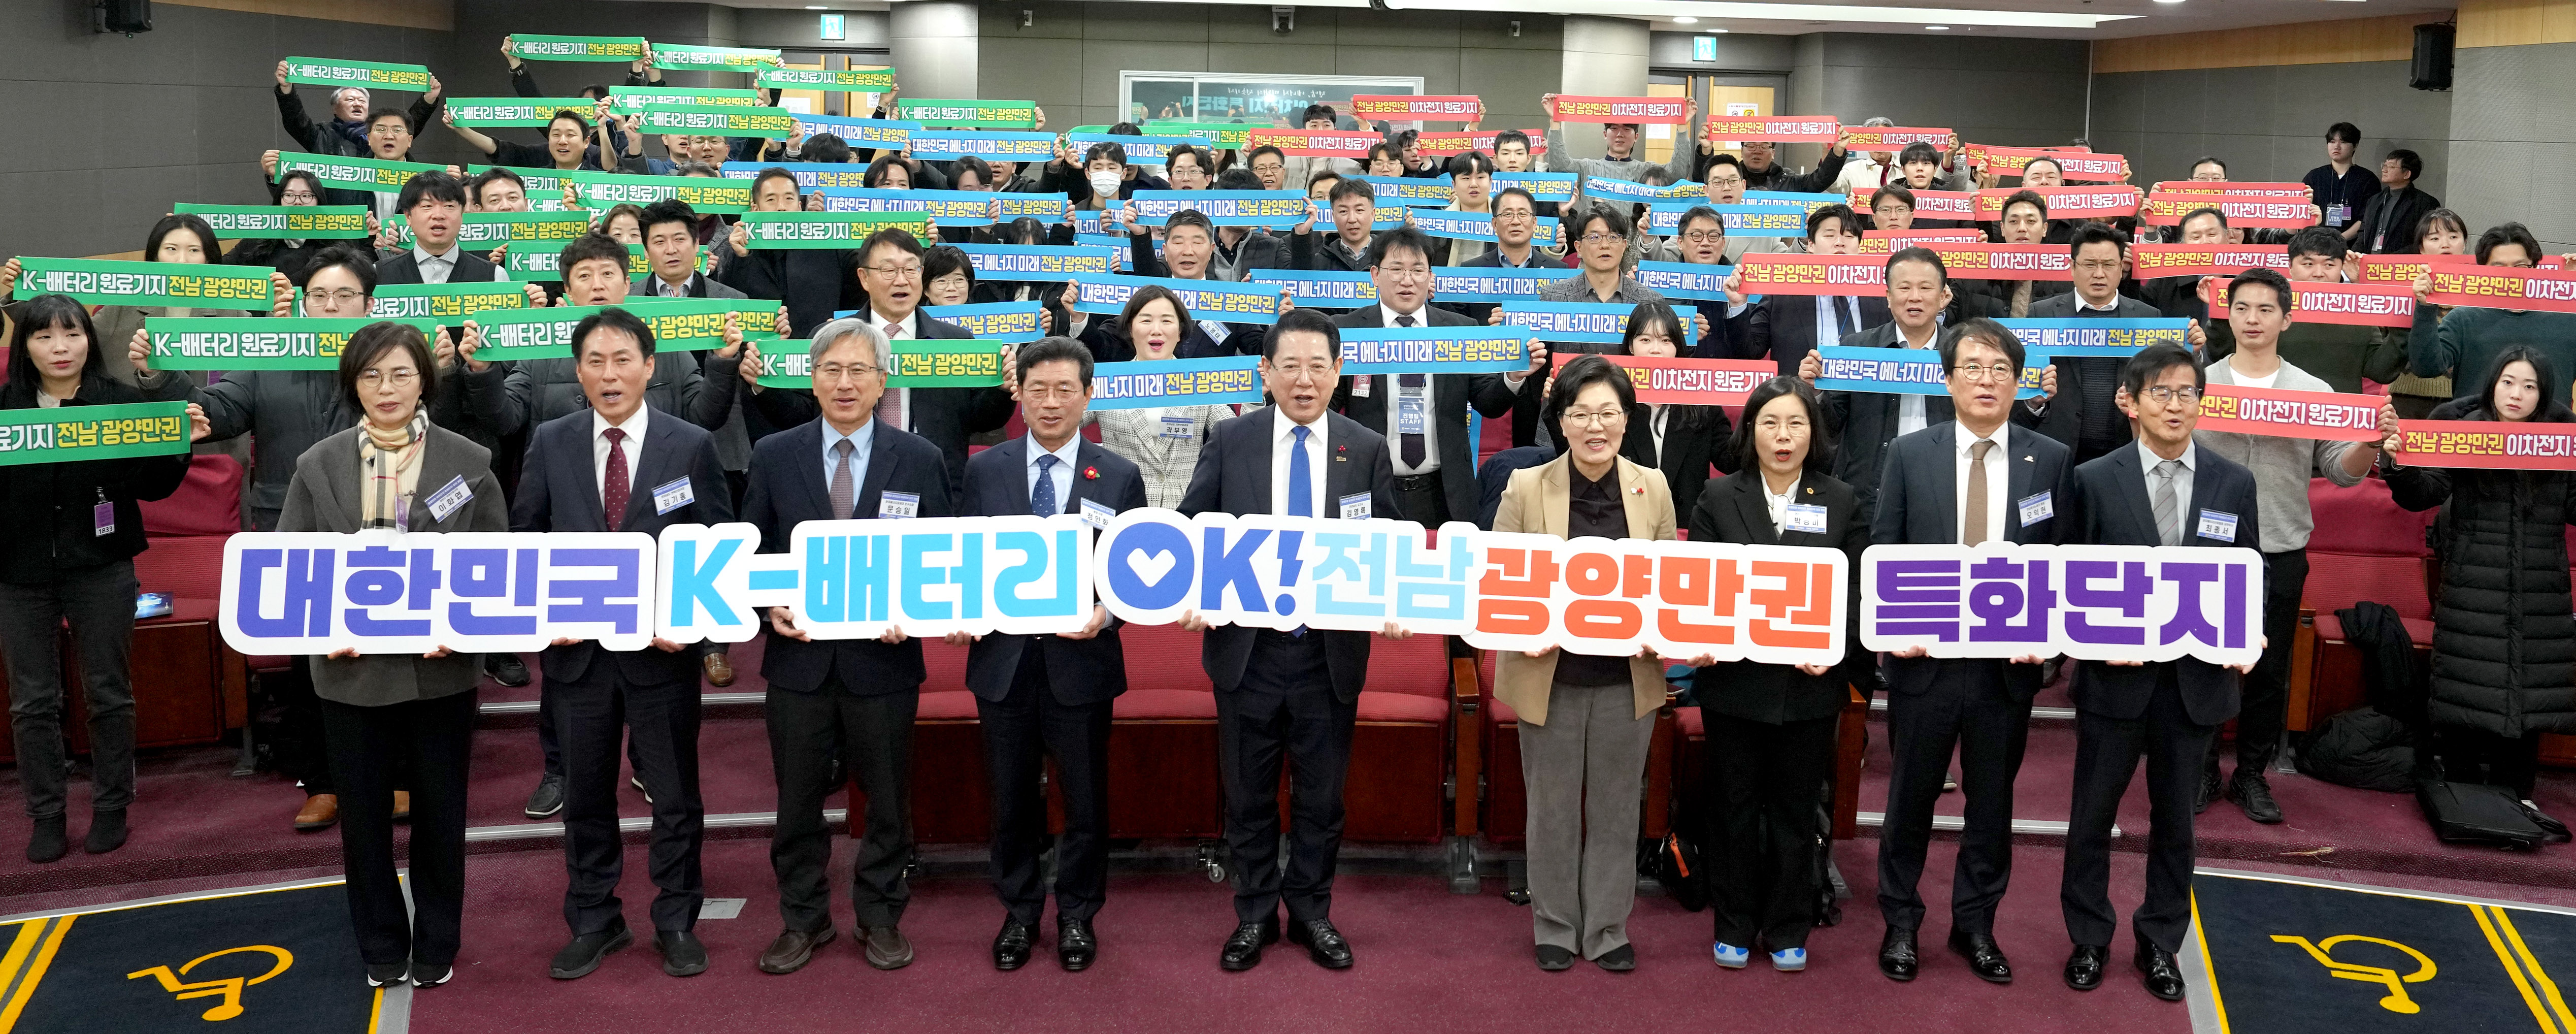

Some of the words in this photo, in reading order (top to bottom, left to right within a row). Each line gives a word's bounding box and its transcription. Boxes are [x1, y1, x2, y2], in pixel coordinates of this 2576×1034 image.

[512, 41, 550, 54] K-배터리
[551, 43, 586, 55] 원료기지
[588, 43, 605, 55] 전남
[606, 44, 641, 56] 광양만권
[289, 63, 331, 79] K-배터리
[333, 67, 370, 81] 원료기지
[371, 70, 390, 82] 전남
[391, 71, 427, 85] 광양만권
[758, 68, 798, 83] K-배터리
[800, 71, 835, 84] 원료기지
[837, 73, 854, 84] 전남
[855, 73, 891, 86] 광양만권
[450, 106, 493, 120] K-배터리
[494, 107, 533, 120] 원료기지
[902, 106, 940, 120] K-배터리
[941, 107, 976, 120] 원료기지
[978, 108, 995, 120] 전남
[997, 108, 1032, 121] 광양만권
[1357, 101, 1374, 113] 전남
[1375, 101, 1408, 113] 광양만권
[1410, 102, 1443, 114] 이차전지
[1444, 102, 1477, 114] 원료기지
[1559, 102, 1575, 114] 전남
[1576, 102, 1610, 116] 광양만권
[1612, 103, 1646, 117] 이차전지
[1648, 103, 1682, 117] 원료기지
[686, 113, 726, 129] 원료기지
[729, 114, 749, 130] 전남
[750, 115, 790, 131] 광양만권
[1711, 121, 1729, 134] 전남
[1730, 121, 1764, 135] 광양만권
[1766, 122, 1800, 135] 이차전지
[1801, 122, 1835, 135] 원료기지
[863, 126, 882, 141] 전남
[912, 137, 948, 153] 대한민국
[949, 139, 976, 153] 에너지
[977, 140, 995, 154] 미래
[996, 140, 1014, 154] 전남
[1309, 136, 1343, 150] 이차전지
[1437, 137, 1471, 150] 광양만권
[1991, 156, 2008, 168] 전남
[331, 167, 376, 183] 원료기지
[377, 169, 399, 185] 전남
[817, 172, 838, 187] 전남
[677, 186, 701, 204] 전남
[703, 188, 750, 206] 광양만권
[1538, 180, 1572, 194] 광양만권
[947, 202, 986, 218] 광양만권
[1003, 200, 1022, 215] 전남
[1023, 200, 1062, 216] 광양만권
[1237, 200, 1259, 216] 전남
[1261, 200, 1303, 216] 광양만권
[1916, 197, 1953, 211] 이차전지
[2049, 193, 2090, 210] 이차전지
[2091, 192, 2134, 209] 원료기지
[2222, 202, 2265, 219] 이차전지
[2267, 203, 2310, 220] 원료기지
[238, 214, 286, 230] 원료기지
[289, 214, 313, 231] 전남
[315, 214, 362, 231] 광양만권
[511, 222, 537, 239] 전남
[538, 221, 587, 239] 광양만권
[1742, 213, 1762, 229] 전남
[1763, 214, 1801, 230] 광양만권
[801, 223, 849, 240] 원료기지
[985, 254, 1016, 271] 에너지
[1018, 254, 1039, 272] 미래
[1041, 255, 1062, 272] 전남
[1942, 251, 1989, 268] 광양만권
[1990, 251, 2038, 270] 이차전지
[2139, 252, 2162, 268] 전남
[2164, 252, 2212, 267] 광양만권
[2215, 252, 2265, 268] 이차전지
[1639, 270, 1681, 289] 대한민국
[1682, 273, 1714, 291] 에너지
[1745, 263, 1772, 282] 전남
[1774, 264, 1826, 283] 광양만권
[1828, 265, 1880, 285] 이차전지
[2367, 264, 2393, 280] 전남
[22, 270, 97, 294] K-배터리
[100, 273, 166, 295] 원료기지
[169, 275, 202, 297] 전남
[204, 276, 267, 299] 광양만권
[1299, 281, 1331, 299] 에너지
[1333, 281, 1354, 299] 미래
[1437, 276, 1479, 294] 대한민국
[1480, 277, 1512, 295] 에너지
[1513, 278, 1534, 295] 미래
[2434, 273, 2465, 294] 전남
[2466, 275, 2524, 298] 광양만권
[432, 295, 461, 315] 전남
[1199, 291, 1224, 310] 전남
[1225, 293, 1275, 314] 광양만권
[2301, 291, 2355, 313] 이차전지
[2358, 294, 2413, 316] 원료기지
[660, 314, 724, 339] 광양만권
[986, 312, 1036, 334] 광양만권
[1555, 313, 1590, 333] 에너지
[1592, 314, 1615, 334] 미래
[154, 333, 238, 357] K-배터리
[242, 333, 315, 356] 원료기지
[2042, 329, 2079, 346] 에너지
[2081, 328, 2105, 346] 미래
[2107, 329, 2132, 346] 전남
[1360, 341, 1402, 363] 에너지
[1404, 340, 1432, 362] 미래
[1435, 339, 1462, 362] 전남
[1465, 338, 1521, 361] 광양만권
[902, 353, 933, 376] 전남
[936, 353, 997, 376] 광양만권
[1822, 359, 1877, 381] 대한민국
[1879, 361, 1922, 383] 에너지
[1135, 373, 1163, 397] 미래
[1166, 372, 1195, 395] 전남
[1197, 370, 1252, 393] 광양만권
[1653, 369, 1711, 392] 이차전지
[2240, 398, 2306, 424] 이차전지
[2308, 404, 2376, 430] 원료기지
[57, 419, 99, 447] 전남
[102, 416, 181, 445] 광양만권
[2406, 432, 2439, 453] 전남
[2440, 433, 2503, 455] 광양만권
[2506, 434, 2570, 457] 이차전지
[98, 527, 113, 535] 1833
[237, 544, 641, 639] 대한민국
[670, 530, 1078, 628] K-배터리
[1312, 532, 1473, 621] 전남
[1477, 546, 1834, 650] 광양만권
[1875, 557, 2247, 650] 특화단지
